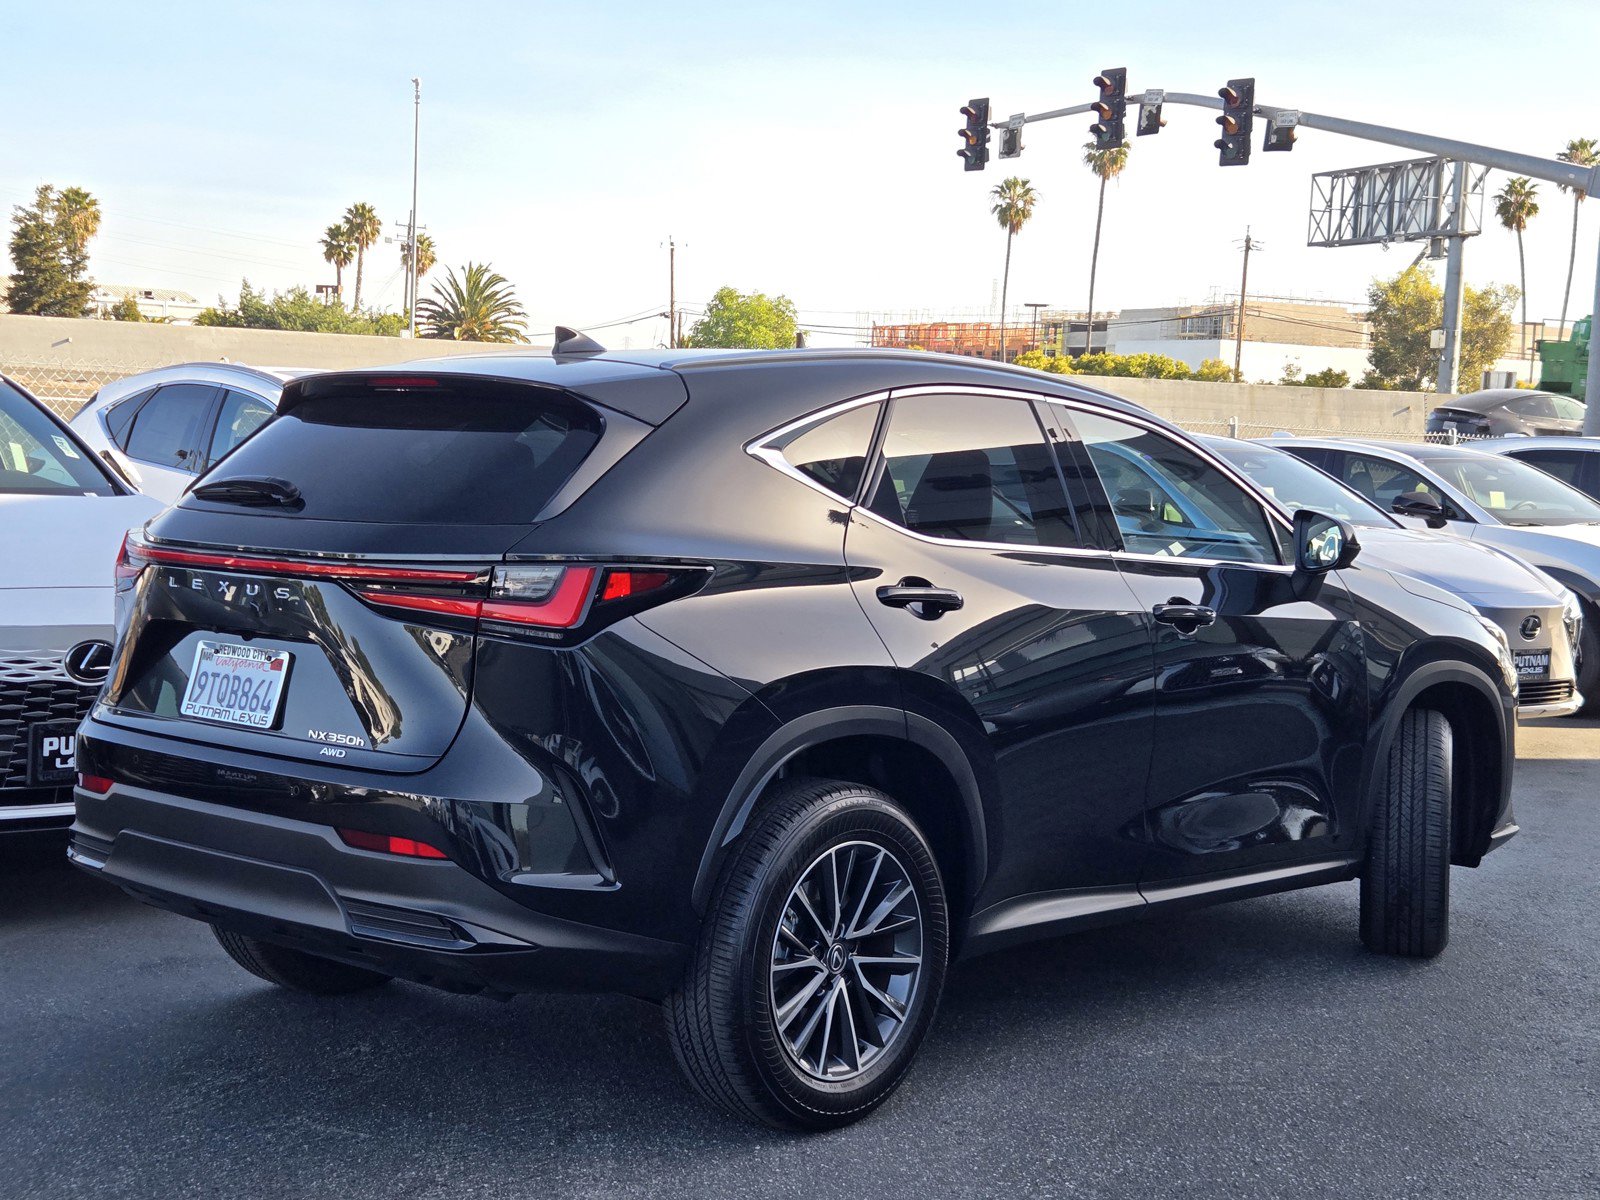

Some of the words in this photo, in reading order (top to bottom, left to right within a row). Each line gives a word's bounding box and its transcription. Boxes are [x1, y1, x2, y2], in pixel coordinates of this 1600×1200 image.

[169, 576, 290, 599] LEXUS
[219, 644, 250, 658] REDWOOD
[215, 656, 270, 672] California
[1514, 655, 1548, 666] PUTNAM
[193, 671, 273, 714] 9TQB864
[185, 703, 230, 719] PUTNAM
[231, 712, 269, 726] LEXUS
[308, 729, 365, 747] NX350h
[320, 747, 346, 758] AWD
